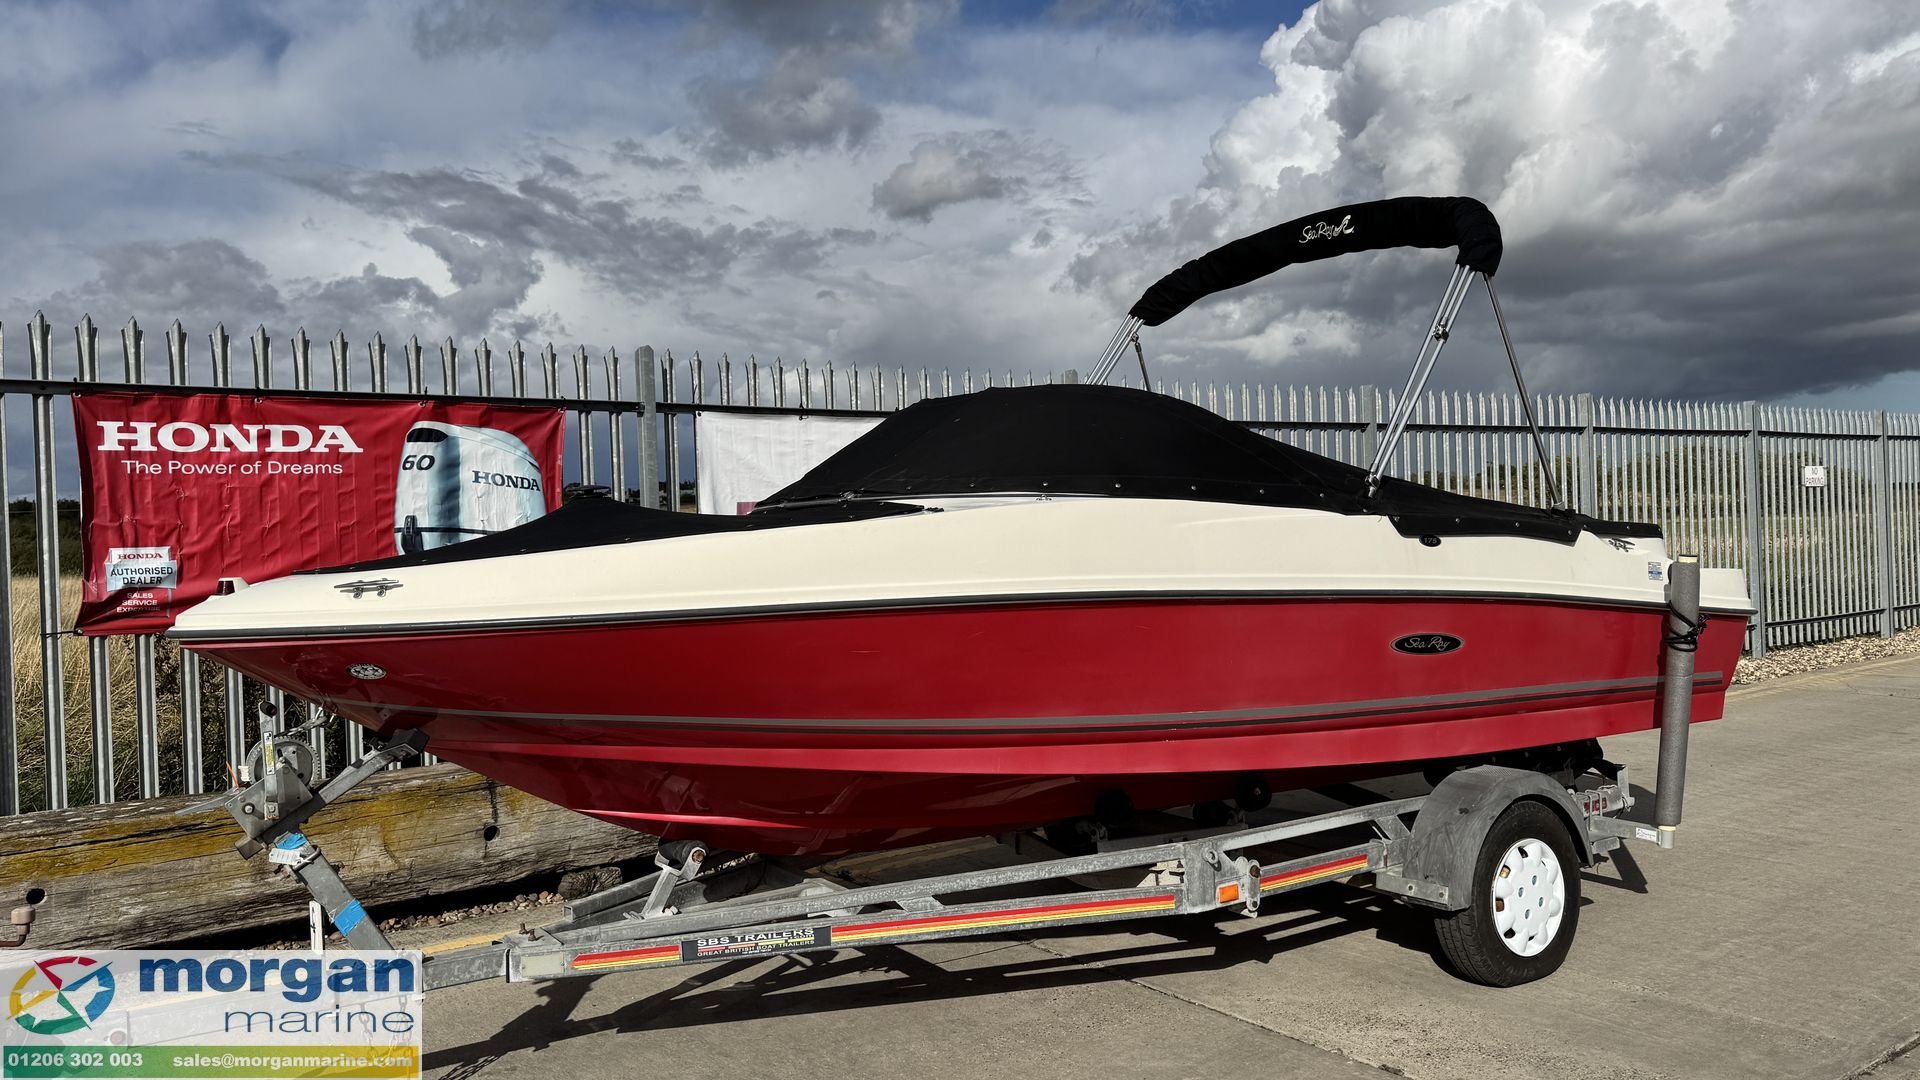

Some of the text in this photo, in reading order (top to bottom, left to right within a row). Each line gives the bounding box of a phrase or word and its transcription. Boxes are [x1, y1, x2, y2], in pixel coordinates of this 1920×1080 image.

[97, 420, 364, 453] HONDA
[121, 459, 343, 475] The Power of Dreams
[402, 454, 436, 471] 60
[471, 470, 541, 492] HONDA
[118, 552, 163, 560] HONDA
[110, 566, 174, 577] AUTHORISED
[122, 577, 163, 585] DEALER
[1404, 636, 1451, 651] Sea Ray
[697, 927, 815, 947] SBS TRAILERS
[724, 945, 755, 954] BRITISH
[778, 939, 815, 948] TRAILERS
